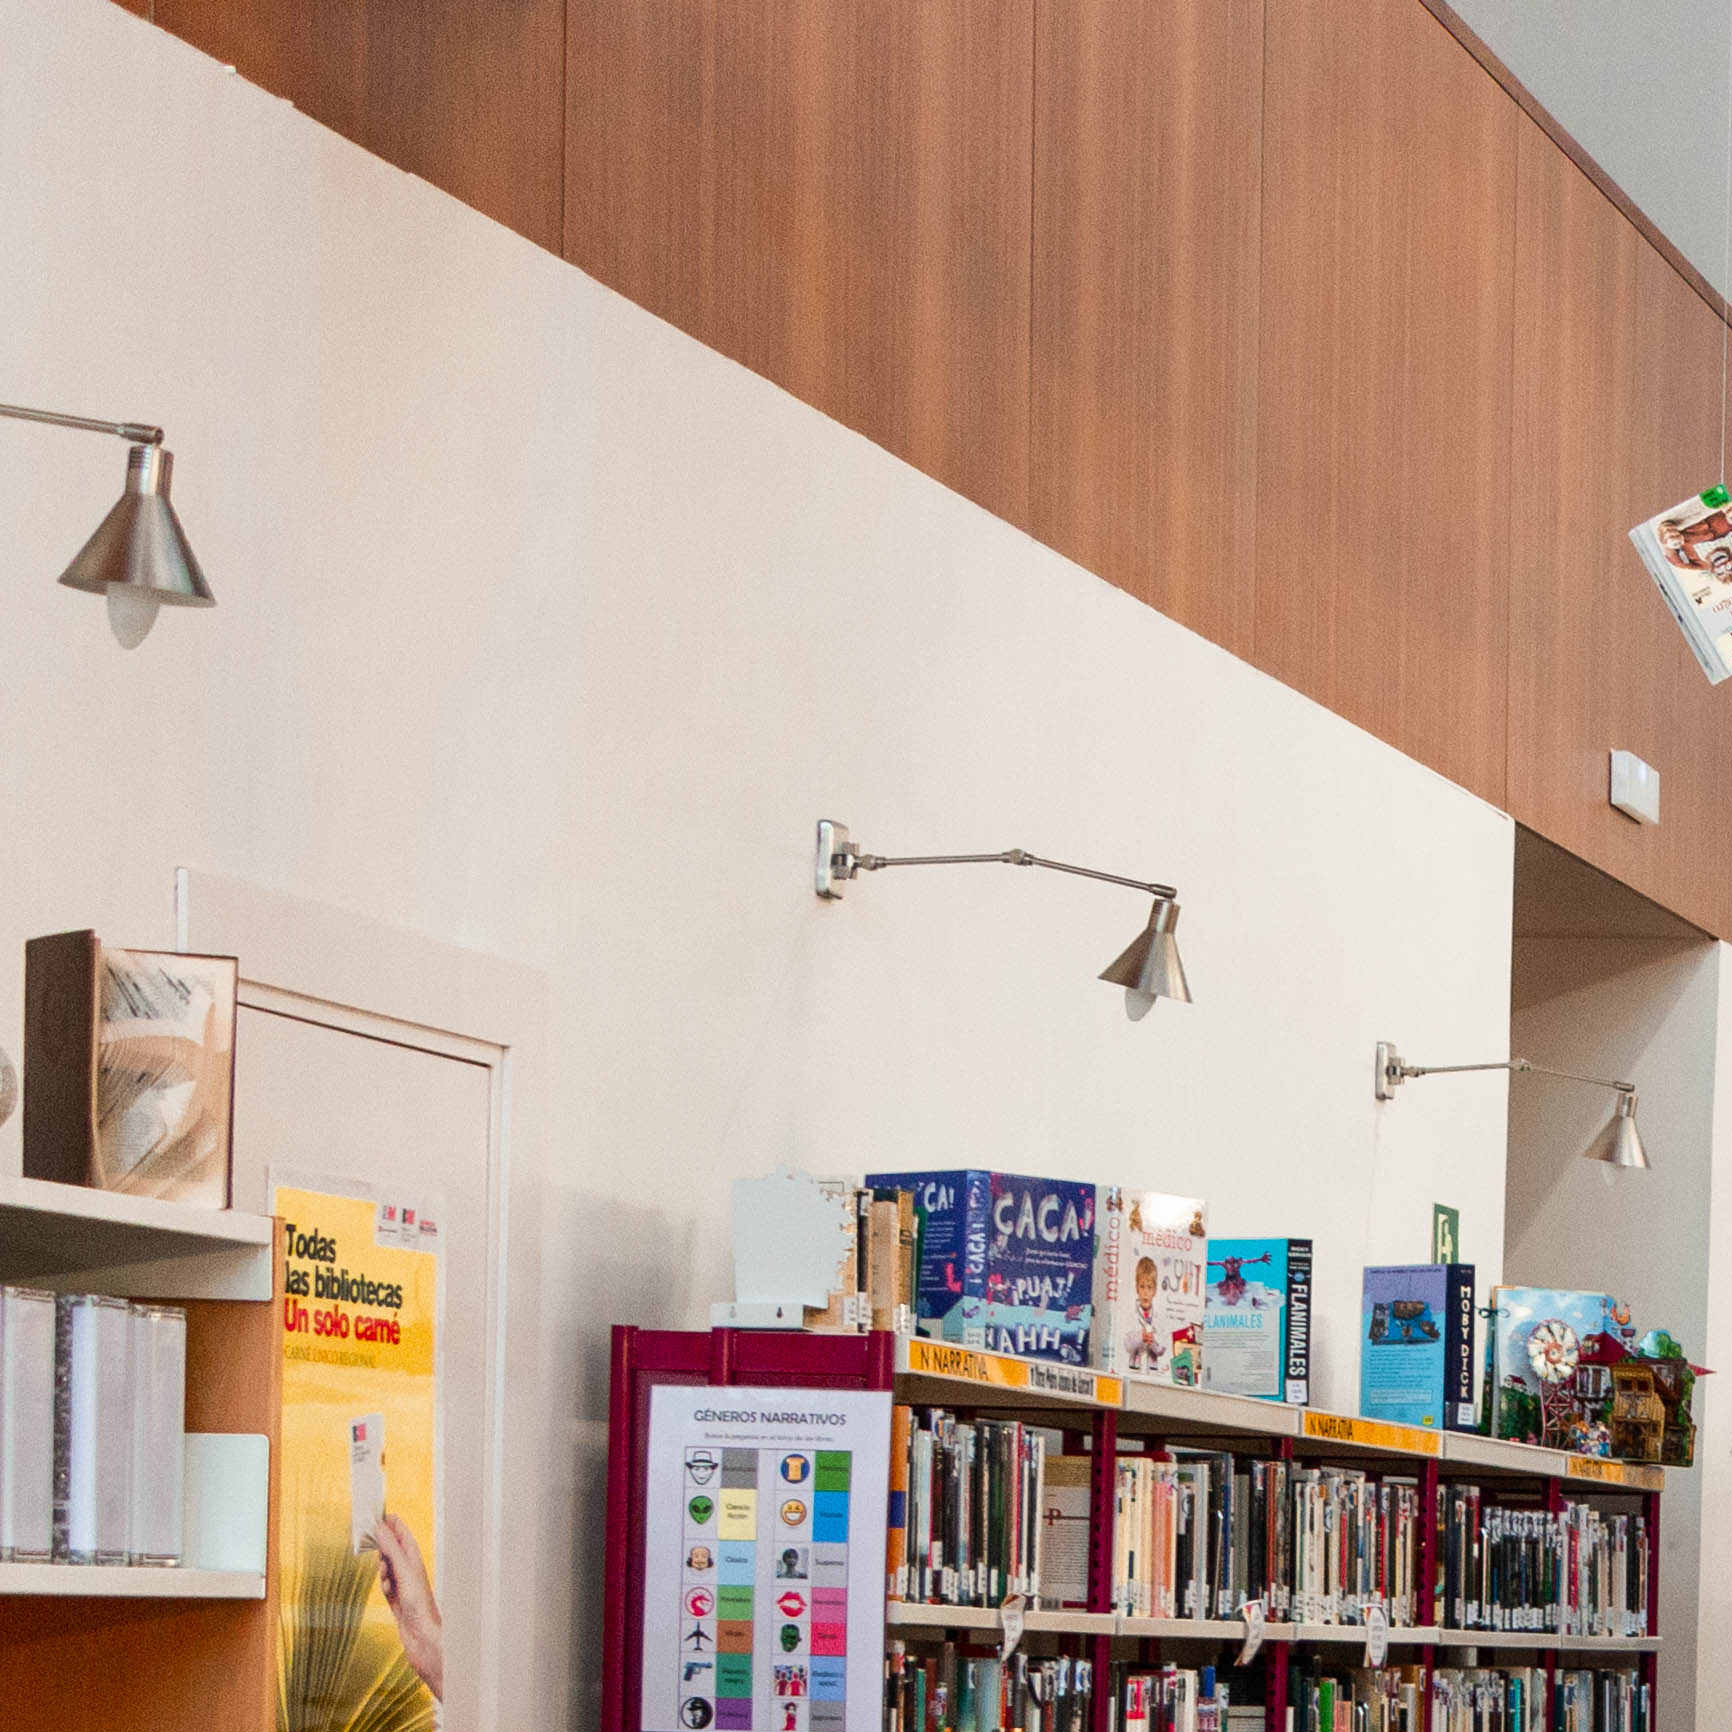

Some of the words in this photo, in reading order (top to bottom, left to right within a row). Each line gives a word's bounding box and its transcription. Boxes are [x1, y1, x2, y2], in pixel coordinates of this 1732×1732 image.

[994, 1190, 1094, 1243] CACA!
[285, 1224, 336, 1263] Todas
[1104, 1216, 1121, 1302] médico
[1141, 1230, 1193, 1252] médico
[285, 1261, 310, 1297] las
[315, 1266, 402, 1309] bibliotecas
[284, 1298, 309, 1333] Un
[314, 1304, 349, 1338] solo
[354, 1312, 400, 1345] carné
[1288, 1283, 1310, 1378] FLANIMALES
[1459, 1284, 1473, 1339] MOBY
[920, 1346, 930, 1366] N
[932, 1348, 990, 1382] NARRATIVA
[1459, 1344, 1472, 1401] DICK
[694, 1409, 757, 1423] GÉNEROS
[760, 1412, 846, 1426] NARRATIVOS
